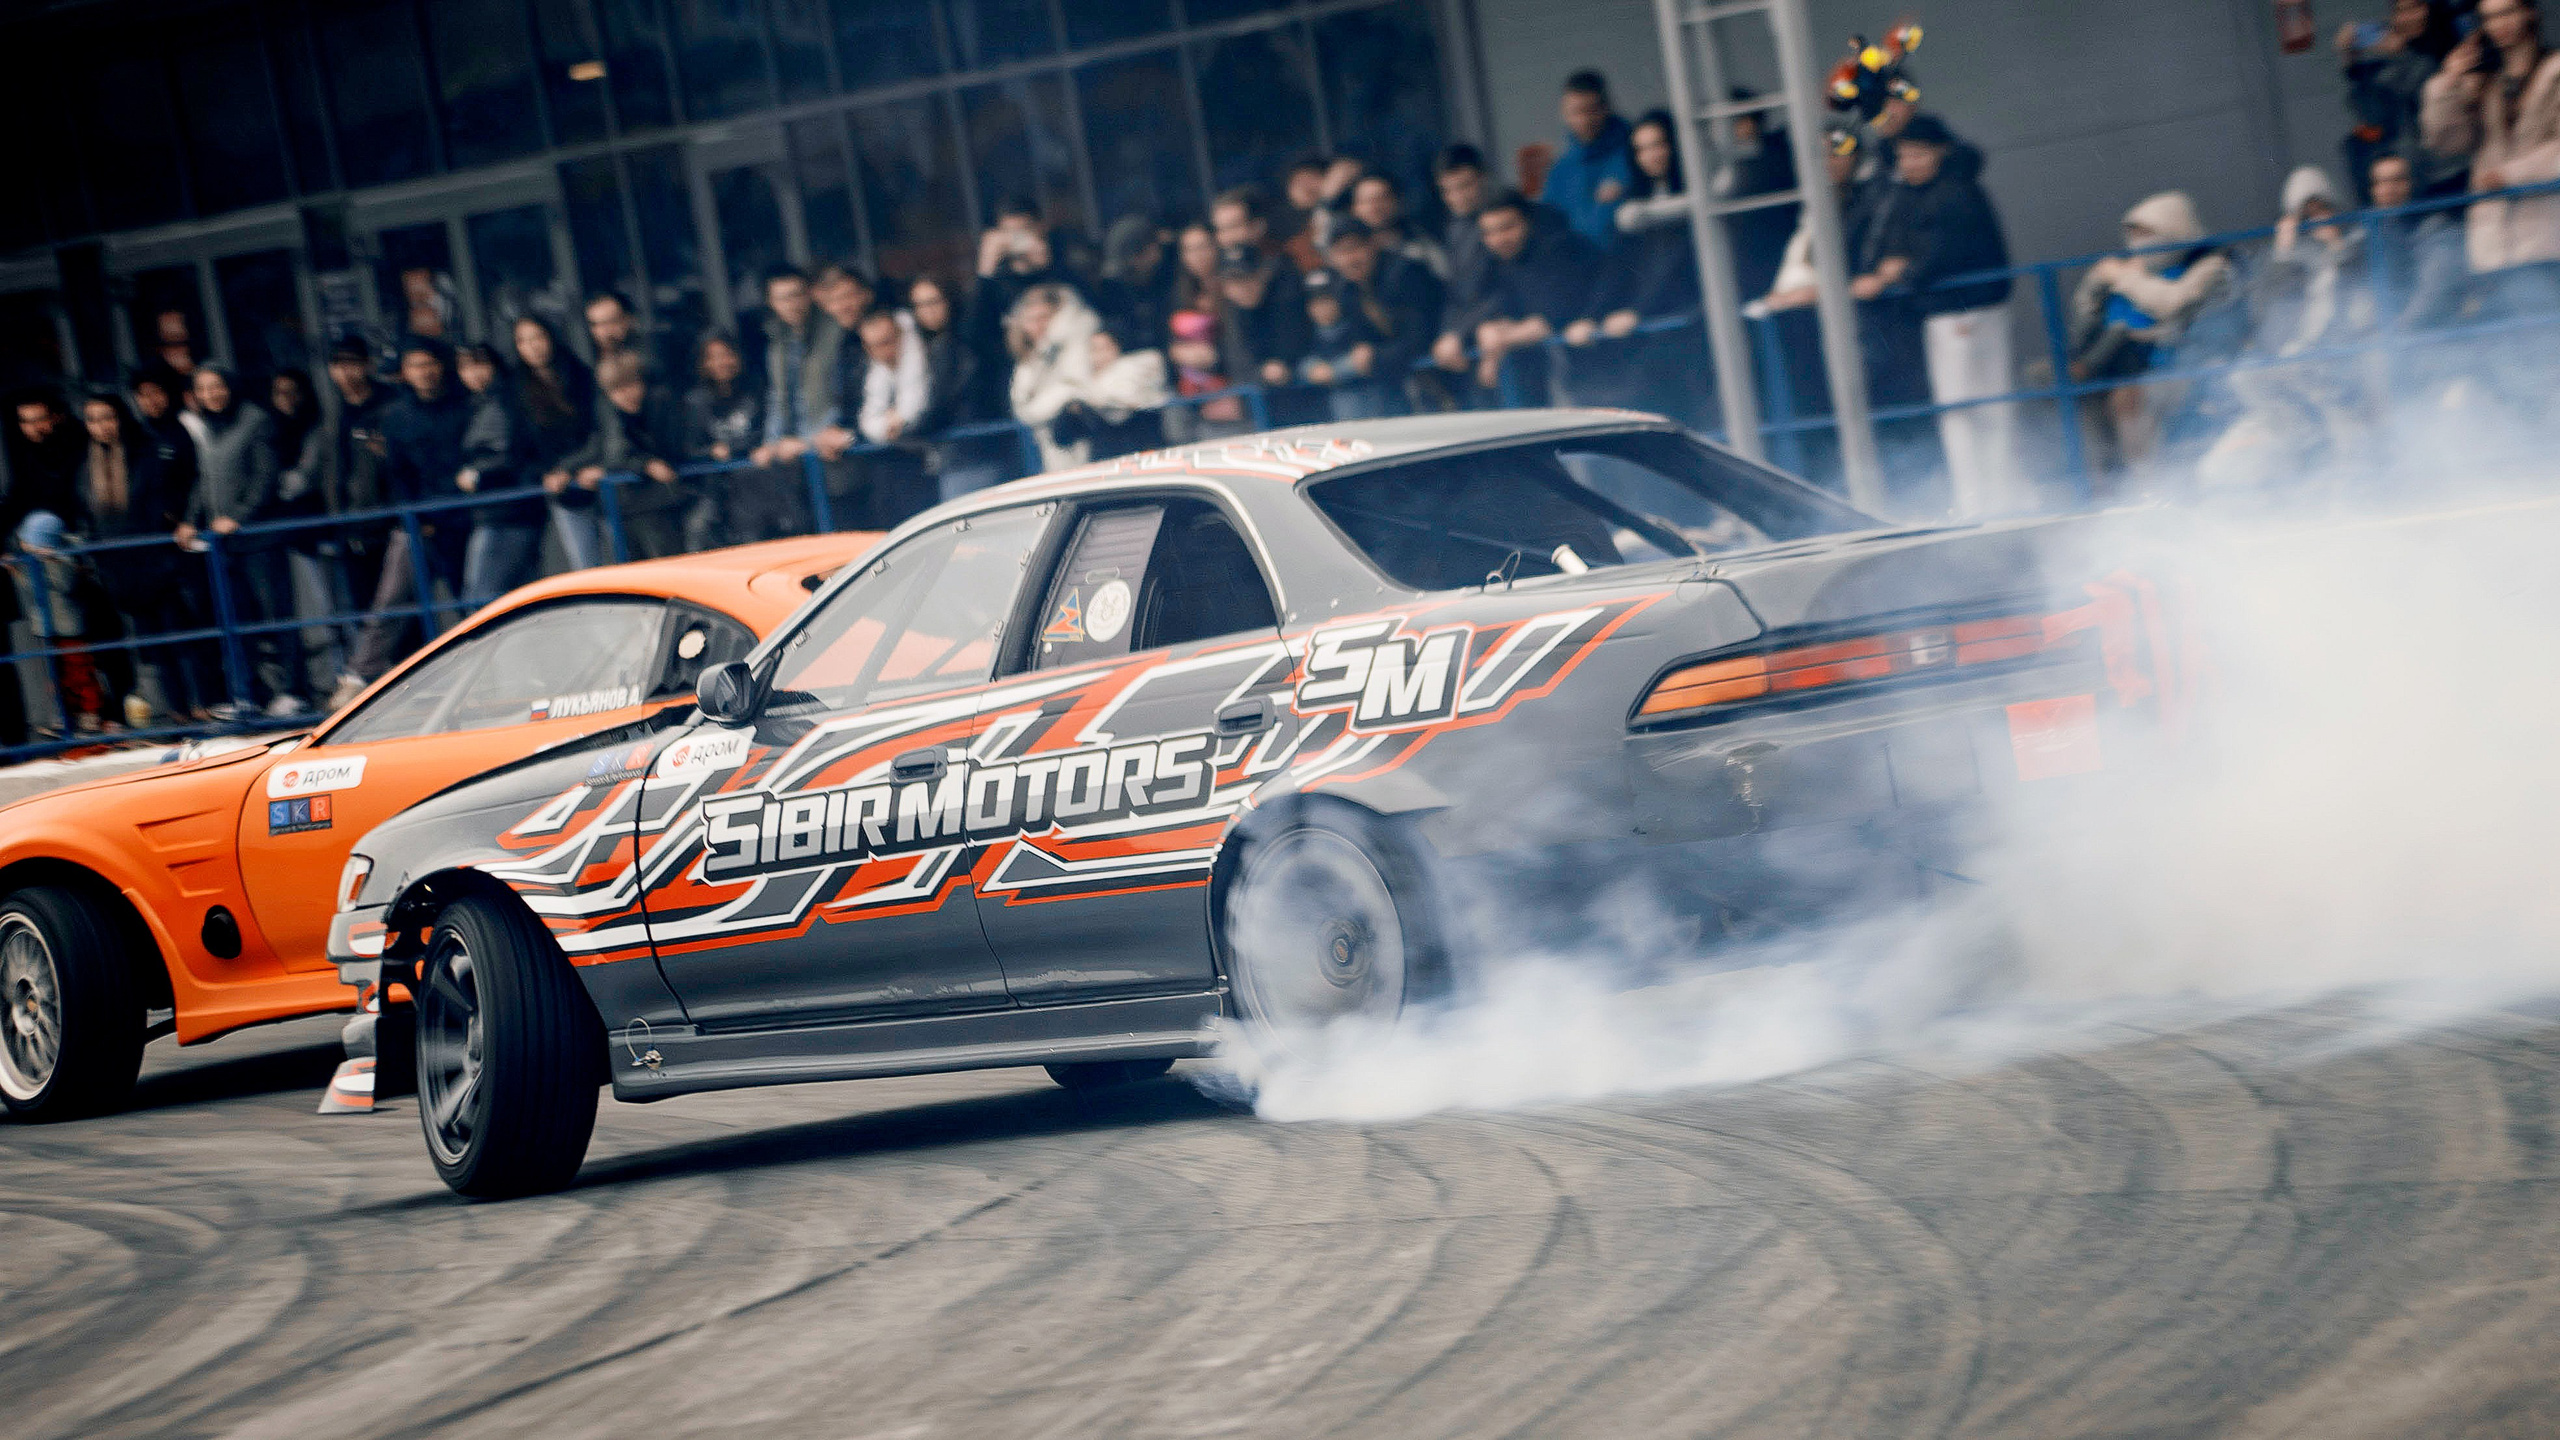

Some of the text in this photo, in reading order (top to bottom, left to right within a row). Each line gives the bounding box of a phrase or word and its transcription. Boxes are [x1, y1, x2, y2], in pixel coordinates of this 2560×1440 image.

[549, 686, 629, 719] ЛУКЬЯНОВ
[1301, 622, 1457, 721] SM
[271, 799, 327, 824] SKR
[704, 735, 1208, 872] SIBIR MOTORS
